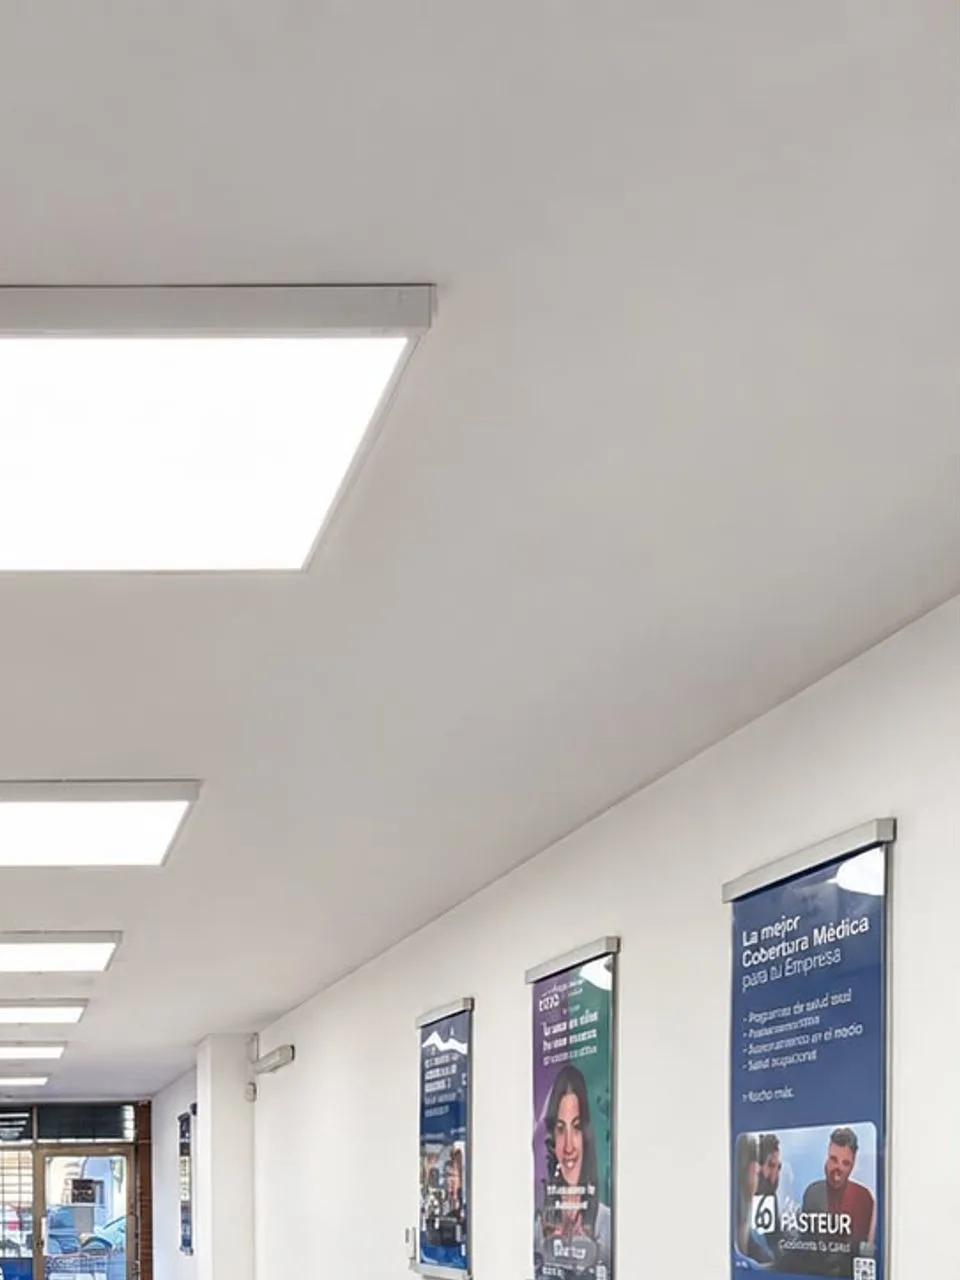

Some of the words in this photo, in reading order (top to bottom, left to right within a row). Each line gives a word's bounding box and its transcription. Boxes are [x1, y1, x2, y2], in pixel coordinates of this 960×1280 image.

[742, 930, 758, 947] La
[742, 935, 809, 968] Cobertura
[780, 1212, 852, 1235] PASTEUR
